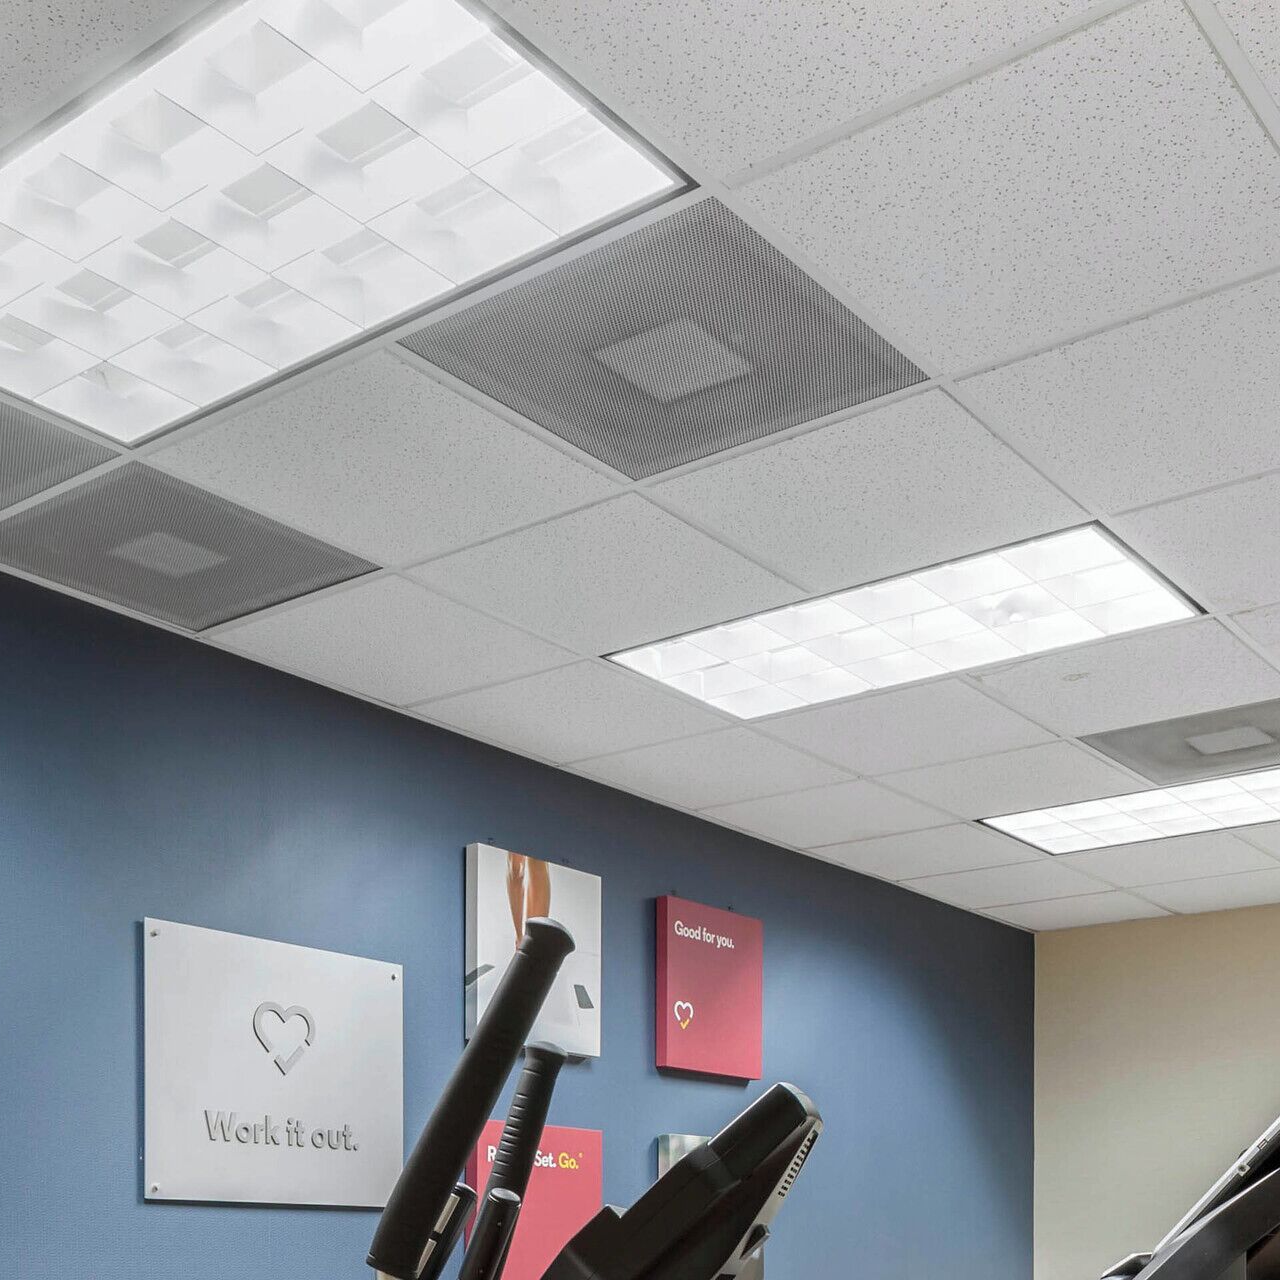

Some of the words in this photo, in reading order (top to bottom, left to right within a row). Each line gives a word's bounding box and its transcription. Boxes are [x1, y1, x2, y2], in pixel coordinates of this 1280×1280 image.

[674, 920, 702, 940] Good
[702, 927, 715, 943] for
[716, 935, 735, 948] you.
[204, 1109, 280, 1146] Work
[286, 1117, 305, 1148] it
[311, 1124, 360, 1151] out.
[533, 1150, 557, 1168] Set.
